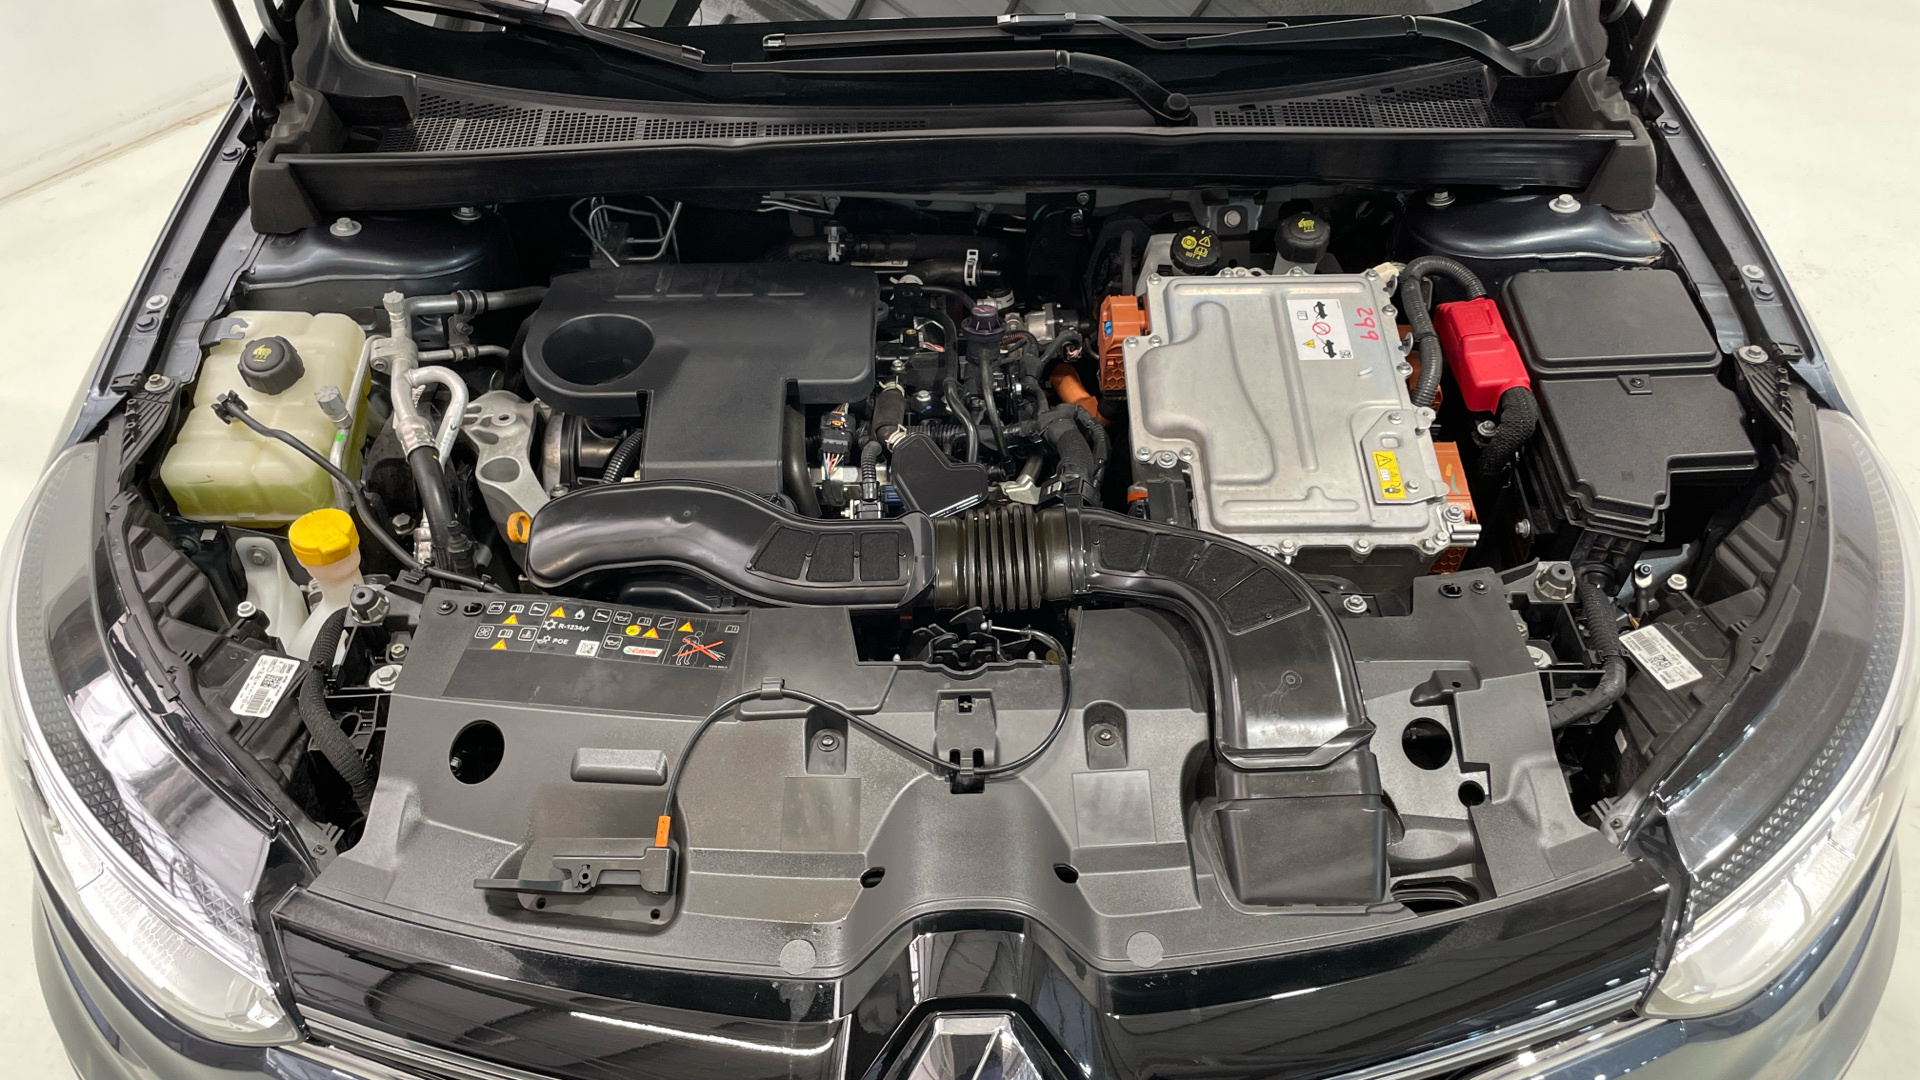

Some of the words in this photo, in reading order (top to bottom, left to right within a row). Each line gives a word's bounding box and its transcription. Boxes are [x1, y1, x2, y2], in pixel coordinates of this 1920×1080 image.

[1354, 307, 1379, 341] 299
[558, 623, 590, 632] R-1234yf
[552, 637, 570, 645] POE
